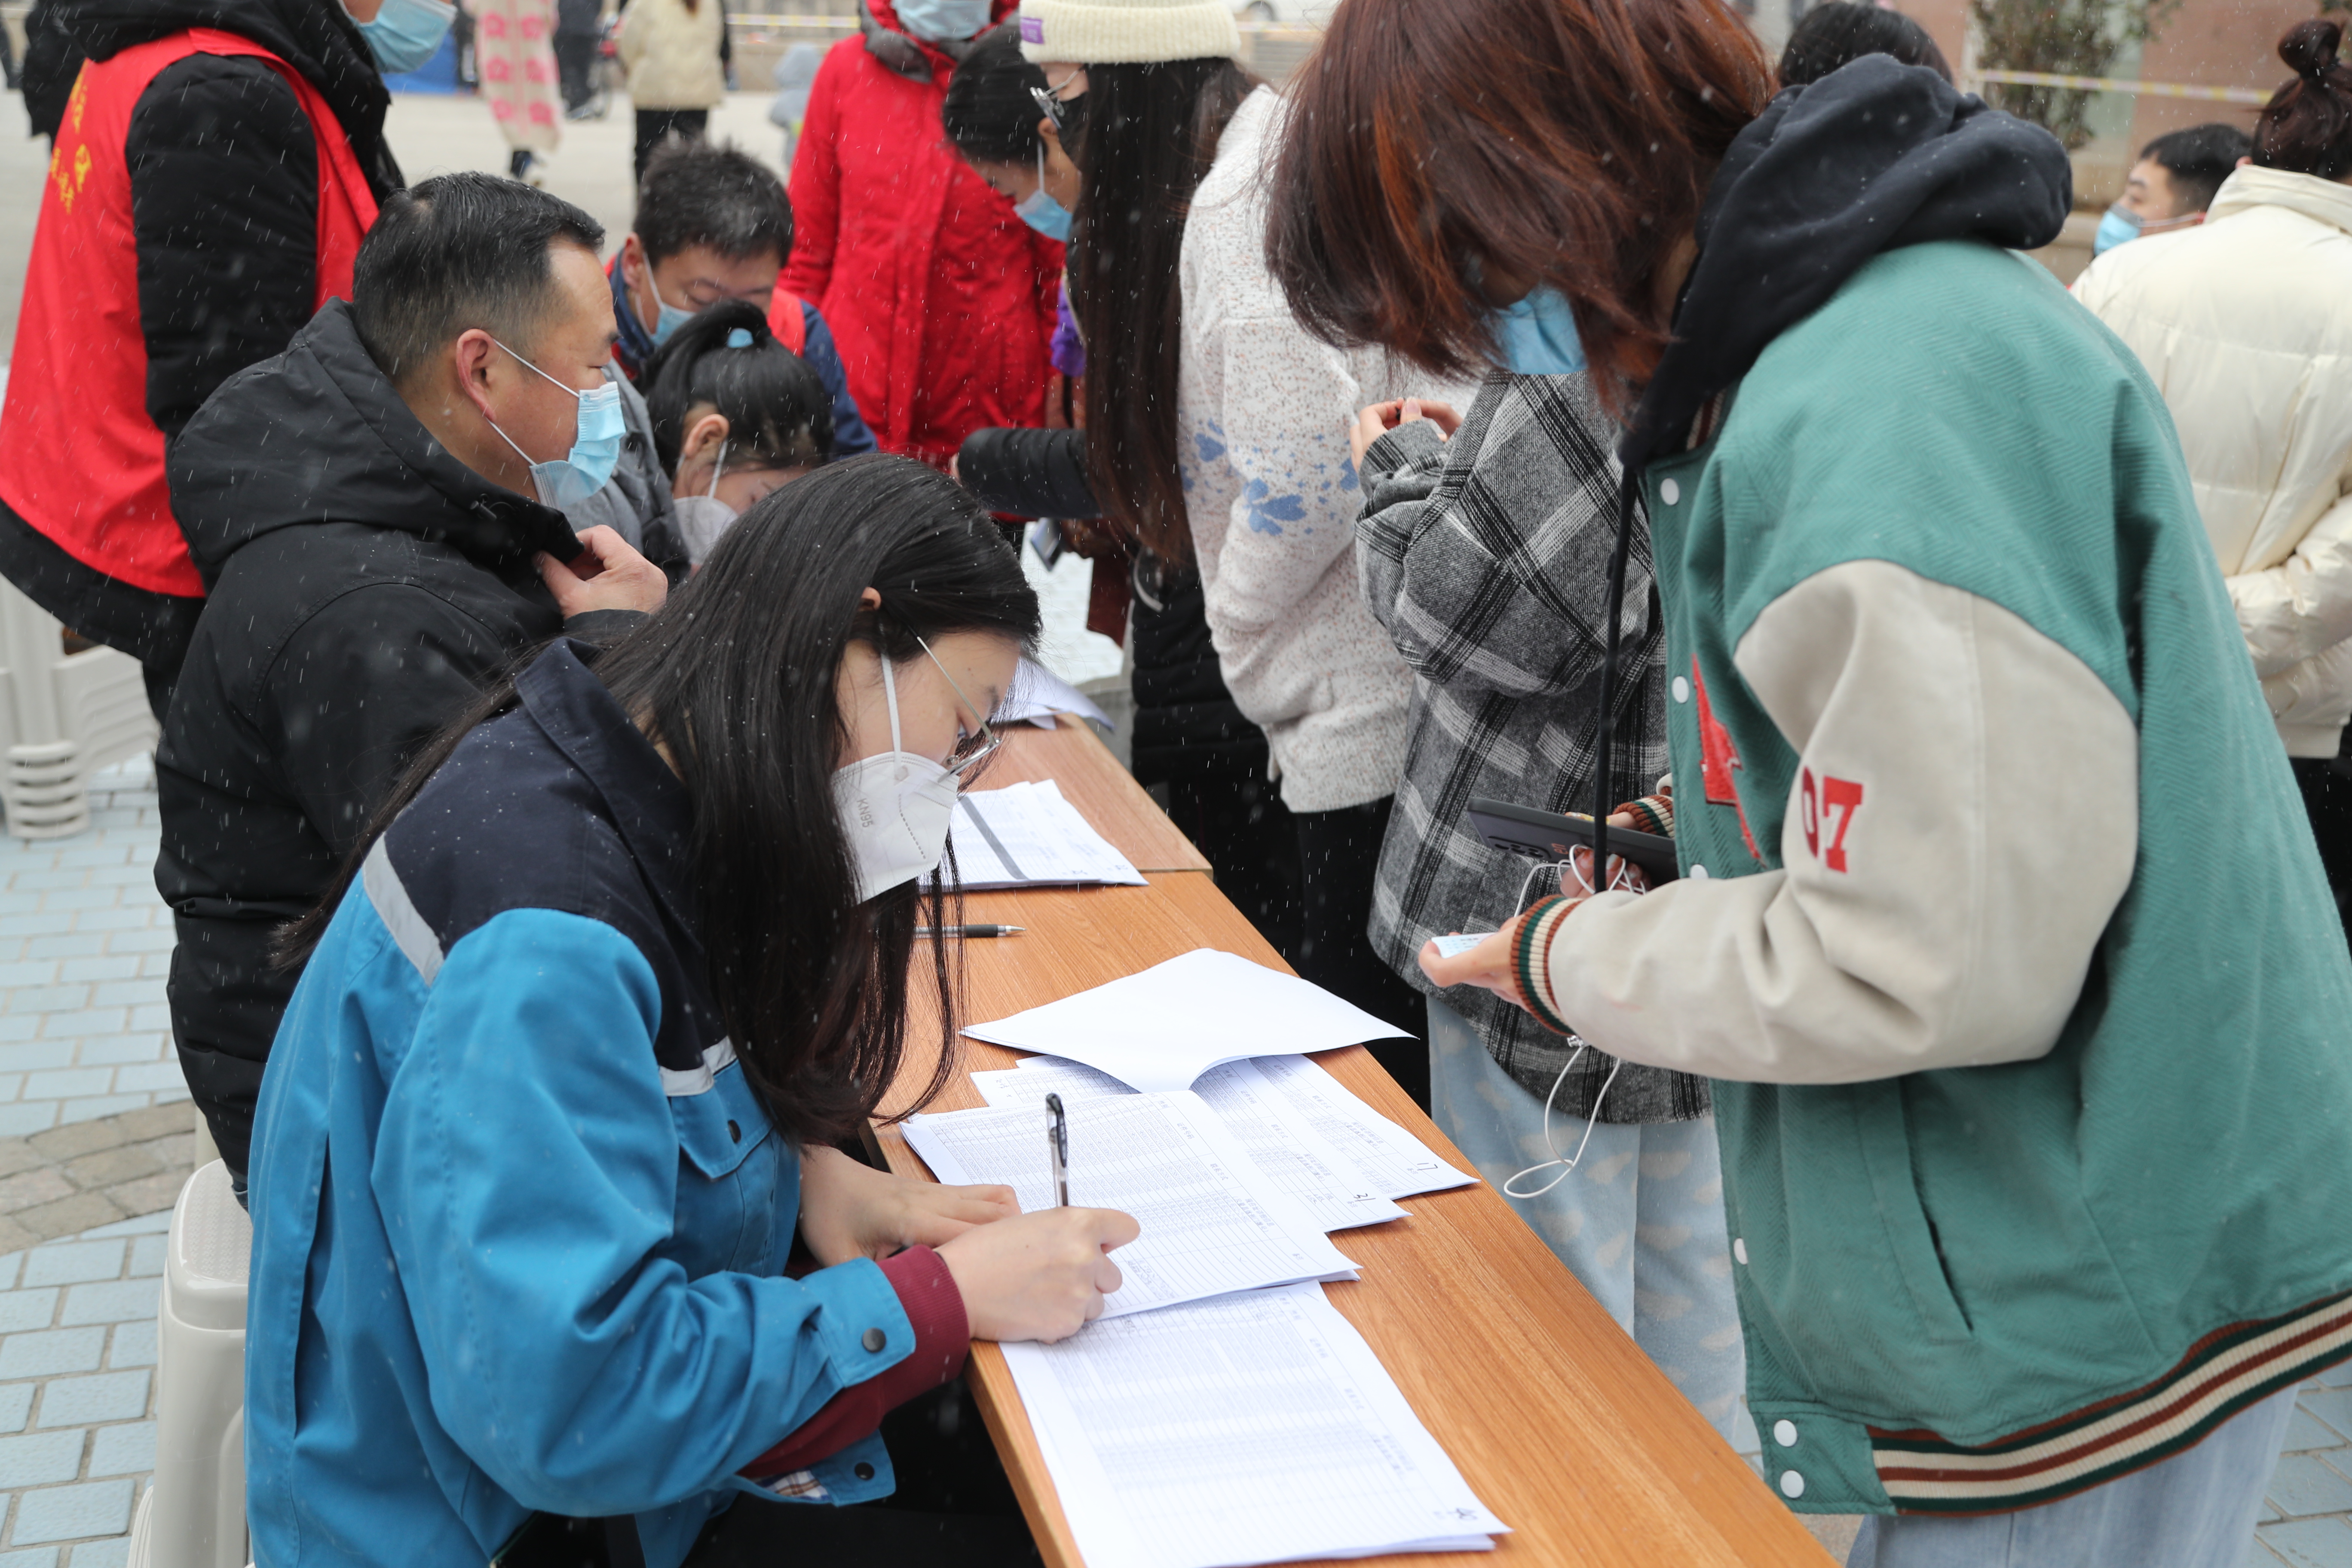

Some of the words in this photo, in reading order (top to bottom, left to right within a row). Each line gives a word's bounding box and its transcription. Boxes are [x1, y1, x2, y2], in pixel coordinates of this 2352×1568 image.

[857, 798, 873, 827] KN95
[1802, 765, 1863, 873] 07
[1240, 1090, 1257, 1104] 证件号码
[1312, 1095, 1332, 1109] 联系方式
[1177, 1122, 1195, 1139] 证件号码
[1271, 1123, 1289, 1139] 联系方式
[1210, 1163, 1229, 1181] 联系方式
[1417, 1162, 1438, 1171] 17
